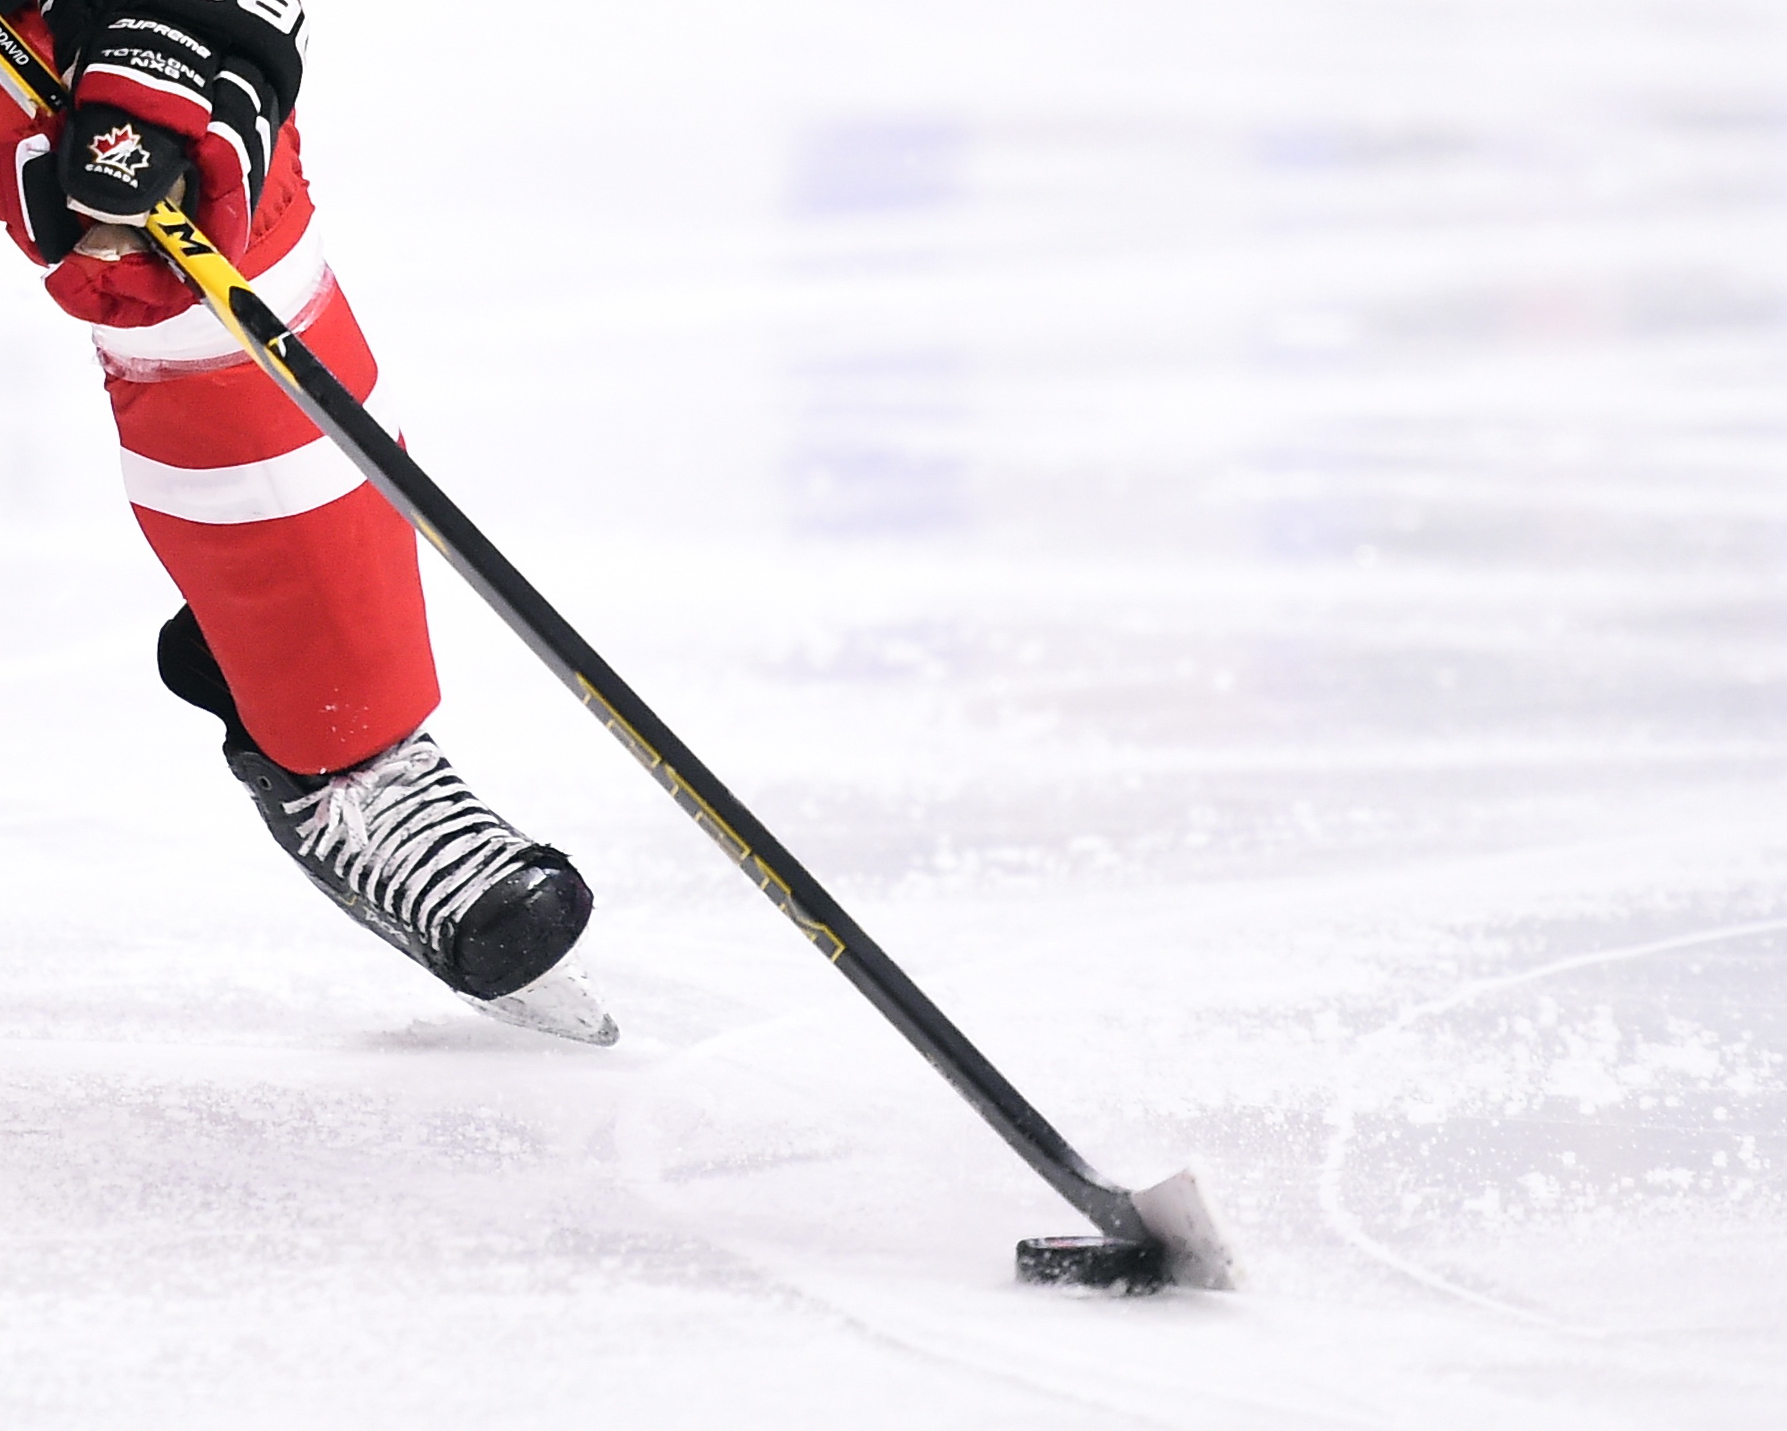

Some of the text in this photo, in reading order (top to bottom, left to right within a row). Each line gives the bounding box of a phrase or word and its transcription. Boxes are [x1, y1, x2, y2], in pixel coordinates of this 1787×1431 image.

[108, 18, 211, 59] SUPREME
[101, 48, 206, 88] TOTALONE
[130, 57, 181, 80] NXG
[84, 163, 139, 189] CANADA
